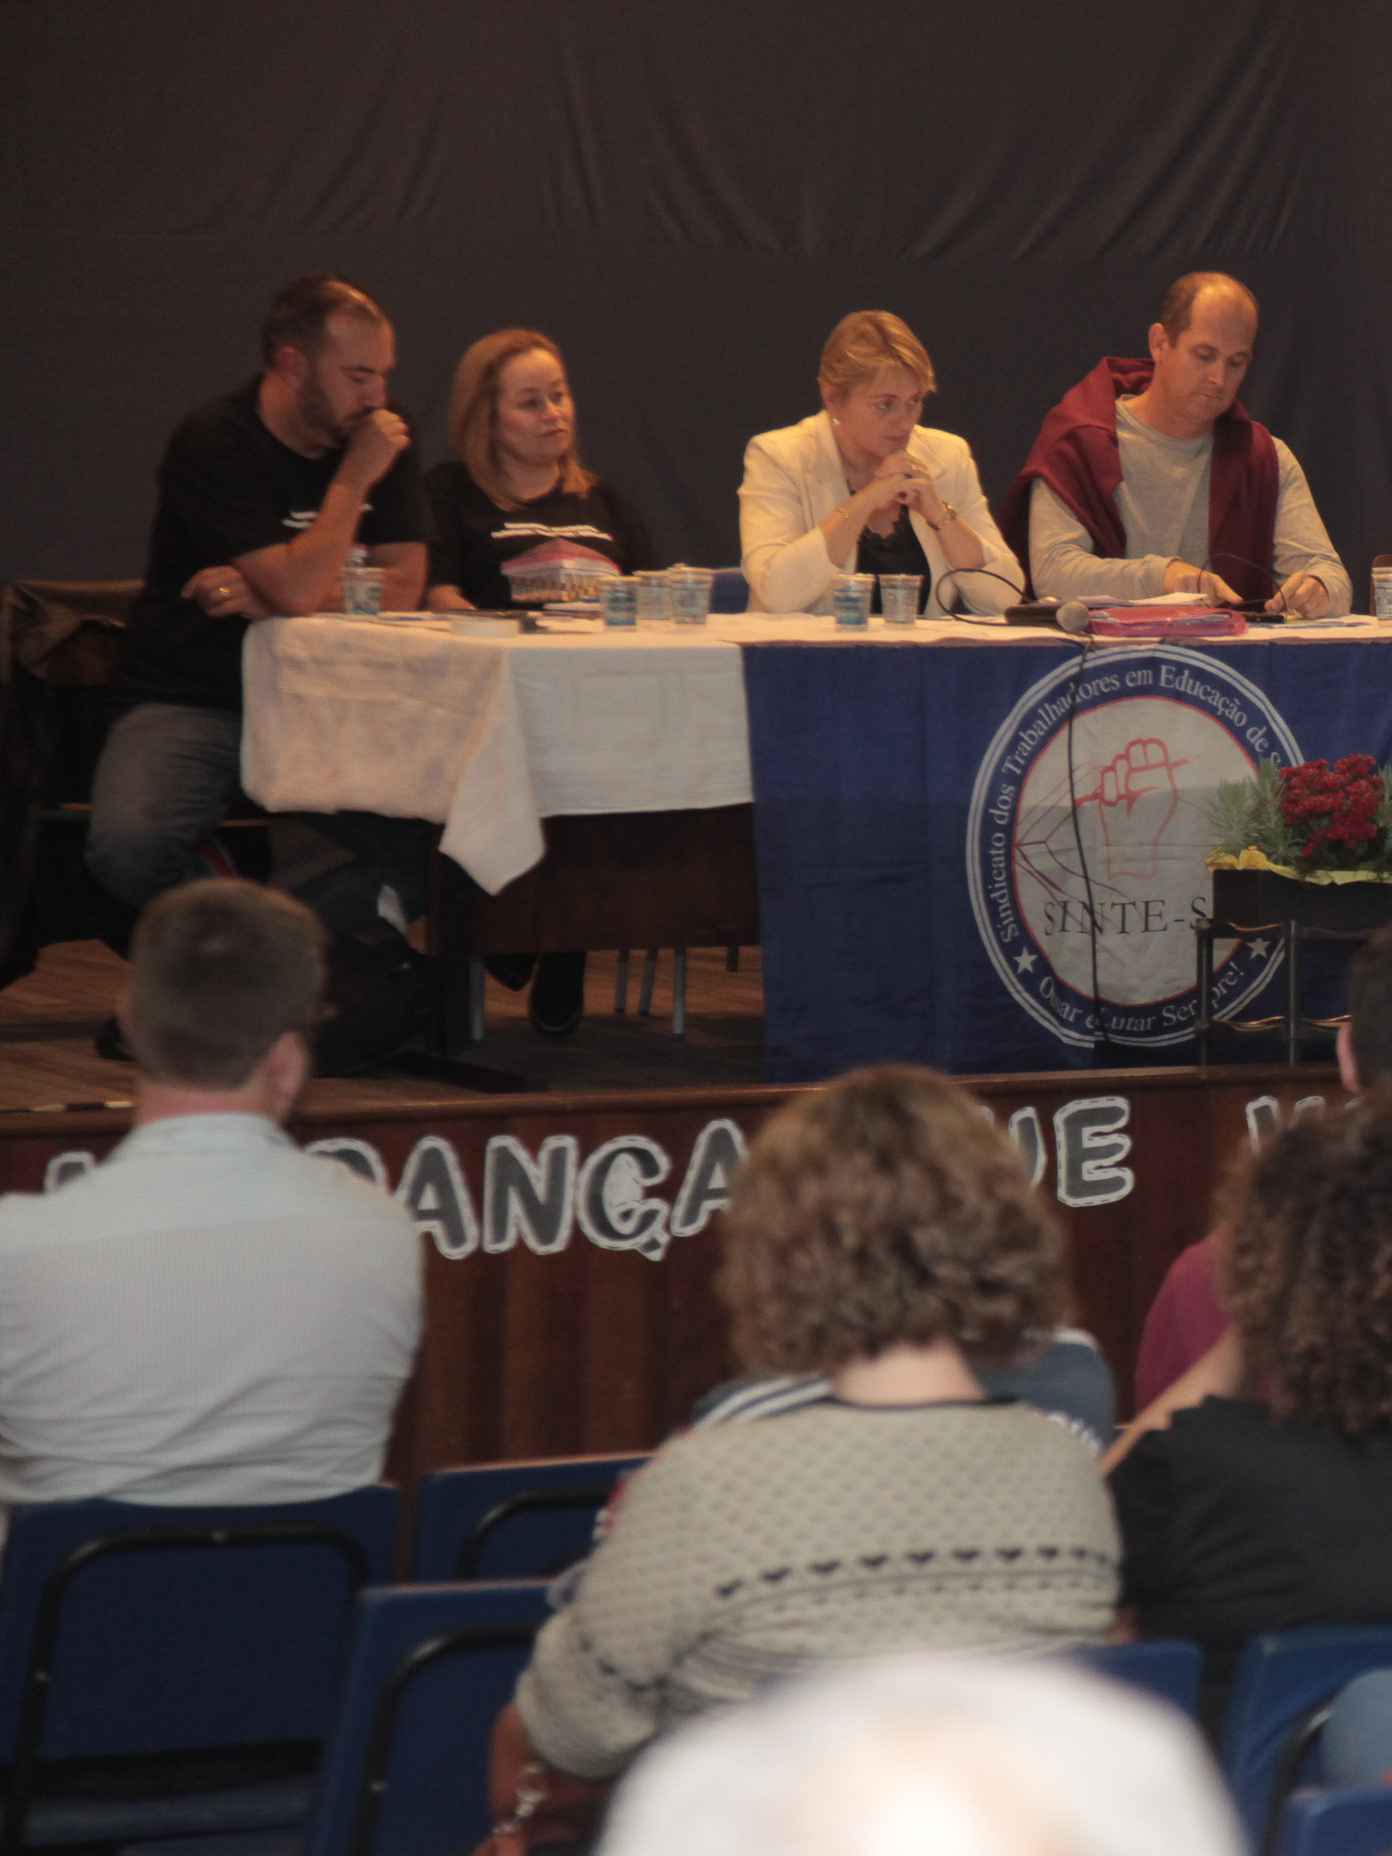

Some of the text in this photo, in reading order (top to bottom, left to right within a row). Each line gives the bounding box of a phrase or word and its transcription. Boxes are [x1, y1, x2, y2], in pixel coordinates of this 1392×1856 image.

[988, 664, 1269, 942] Sindicato dos Trabalhadores em Educação de
[1043, 896, 1208, 936] SINTE-S
